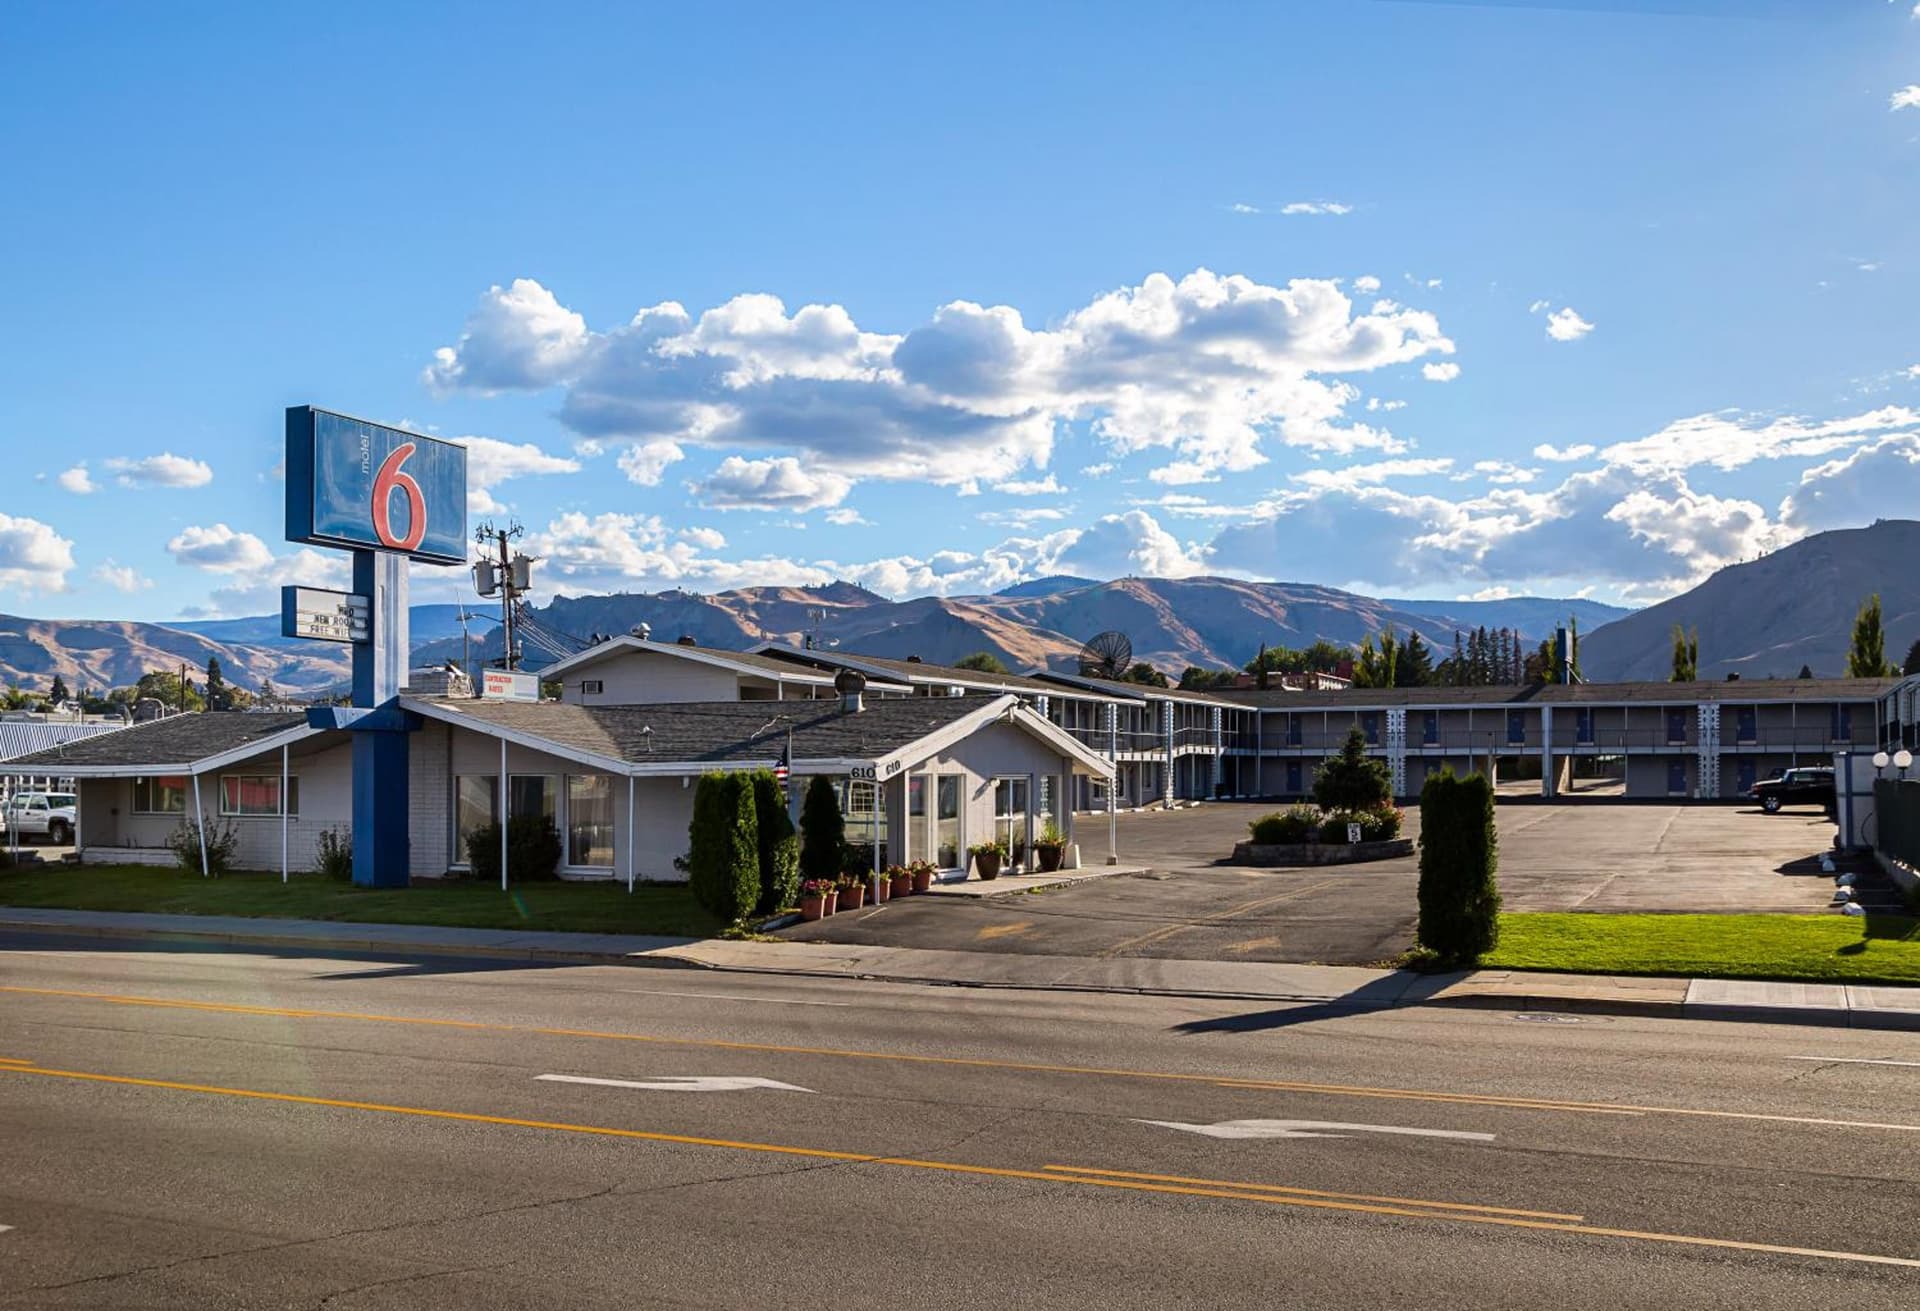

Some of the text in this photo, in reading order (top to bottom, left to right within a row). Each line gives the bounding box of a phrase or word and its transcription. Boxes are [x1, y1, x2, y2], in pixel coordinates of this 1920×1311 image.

[360, 434, 370, 475] motel
[371, 442, 427, 551] 6
[310, 624, 329, 633] FREE
[851, 767, 876, 778] 610
[886, 760, 901, 775] 610
